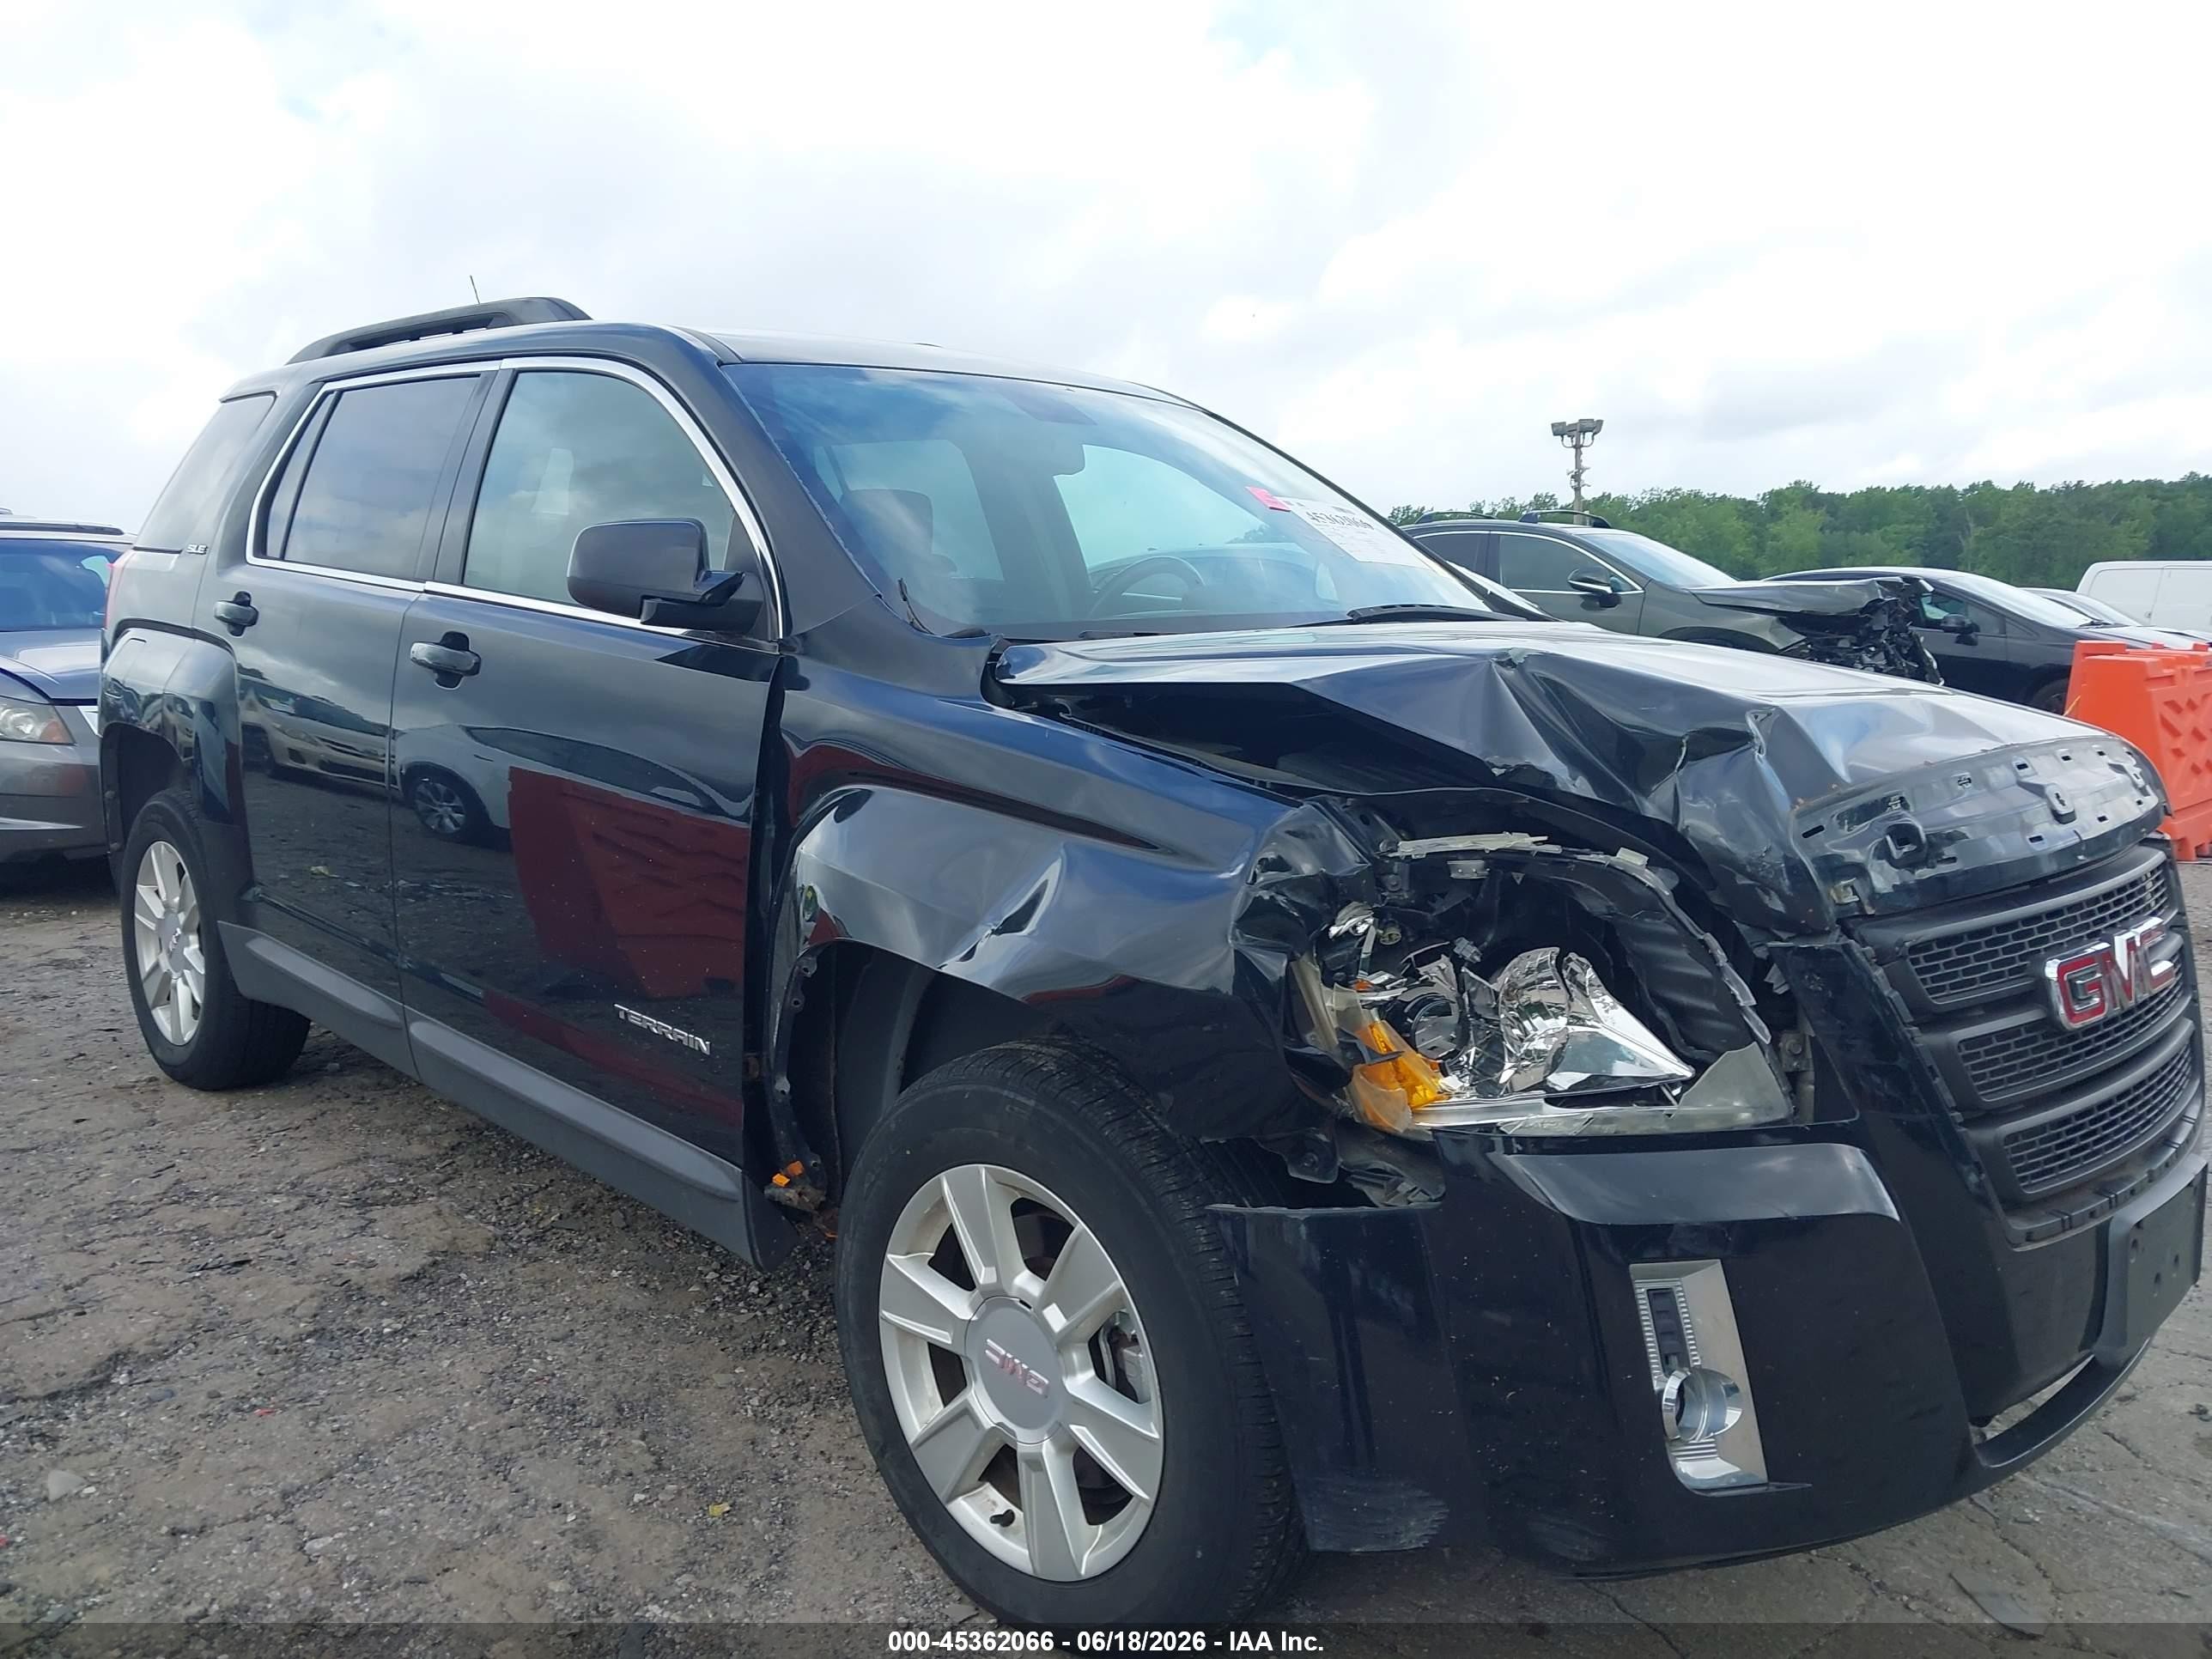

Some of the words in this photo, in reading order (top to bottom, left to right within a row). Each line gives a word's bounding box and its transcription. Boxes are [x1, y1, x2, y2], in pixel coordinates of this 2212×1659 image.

[186, 543, 208, 556] SLE
[2045, 916, 2176, 1030] GMC
[613, 1003, 711, 1055] TERRAIN
[985, 1338, 1049, 1396] GMC
